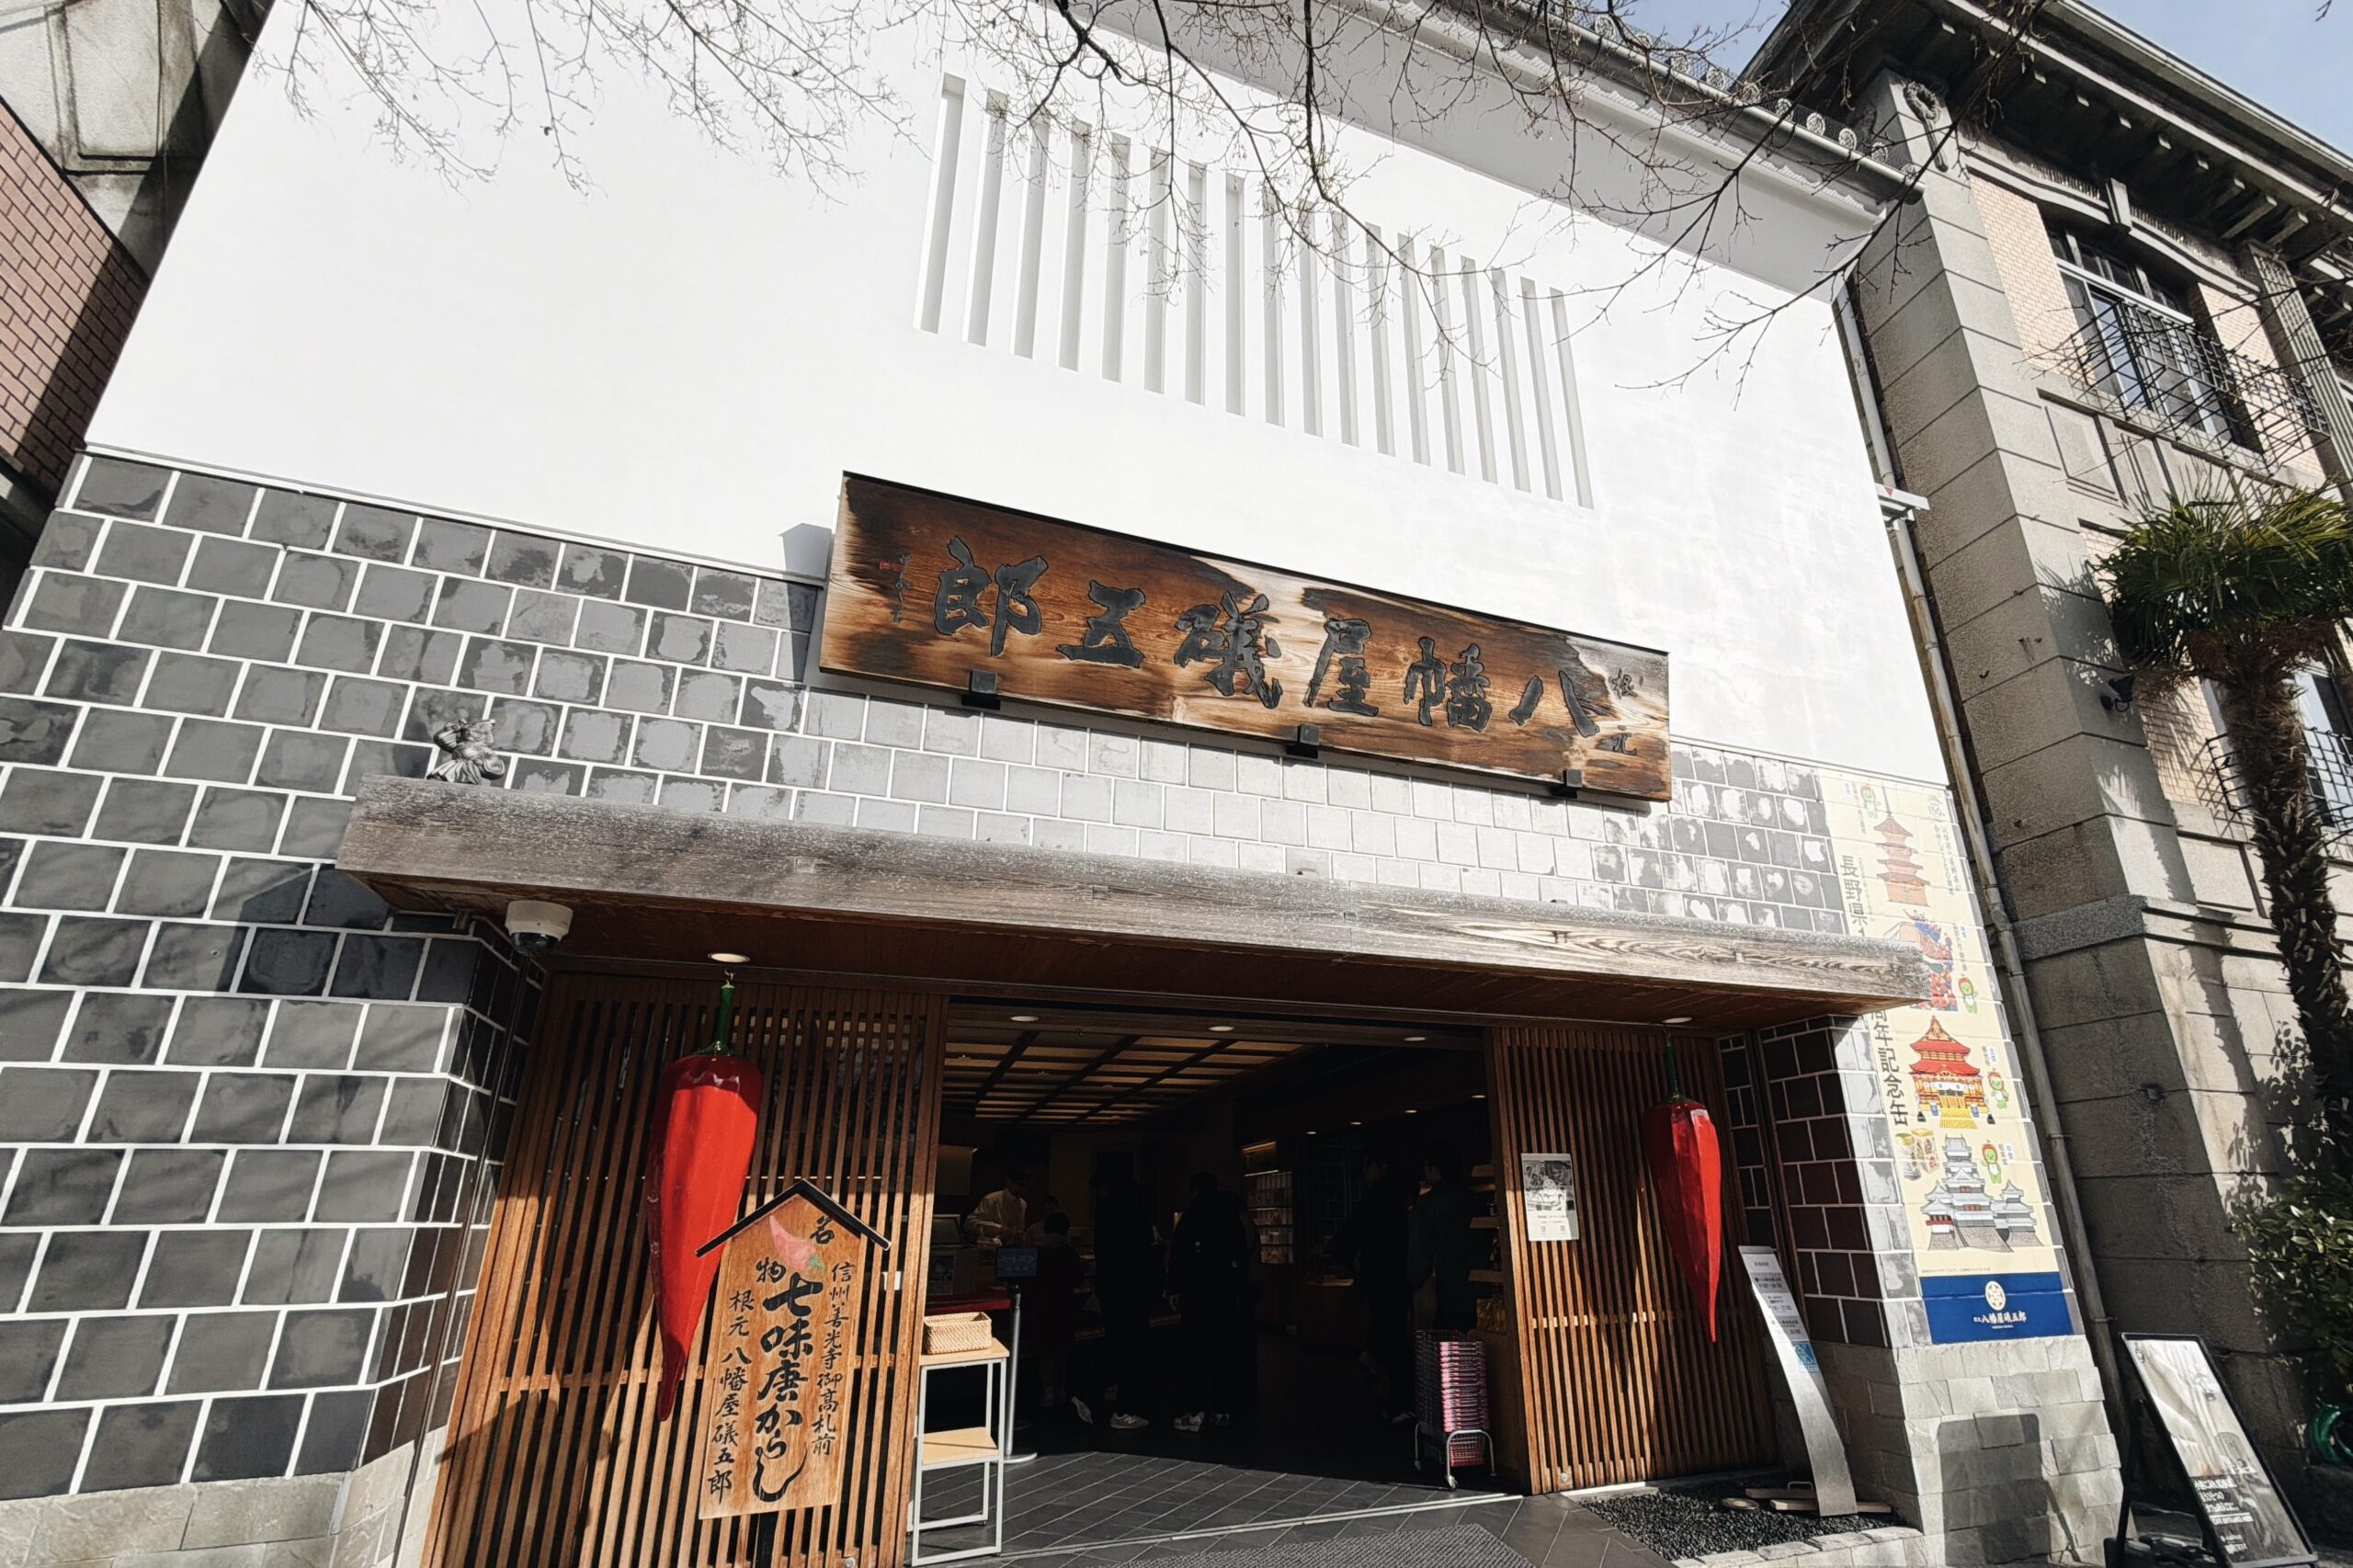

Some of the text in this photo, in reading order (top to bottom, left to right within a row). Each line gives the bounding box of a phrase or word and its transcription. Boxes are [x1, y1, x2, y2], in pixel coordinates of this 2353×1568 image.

[1610, 668, 1638, 756] 根元
[752, 1272, 824, 1503] 七味唐からし
